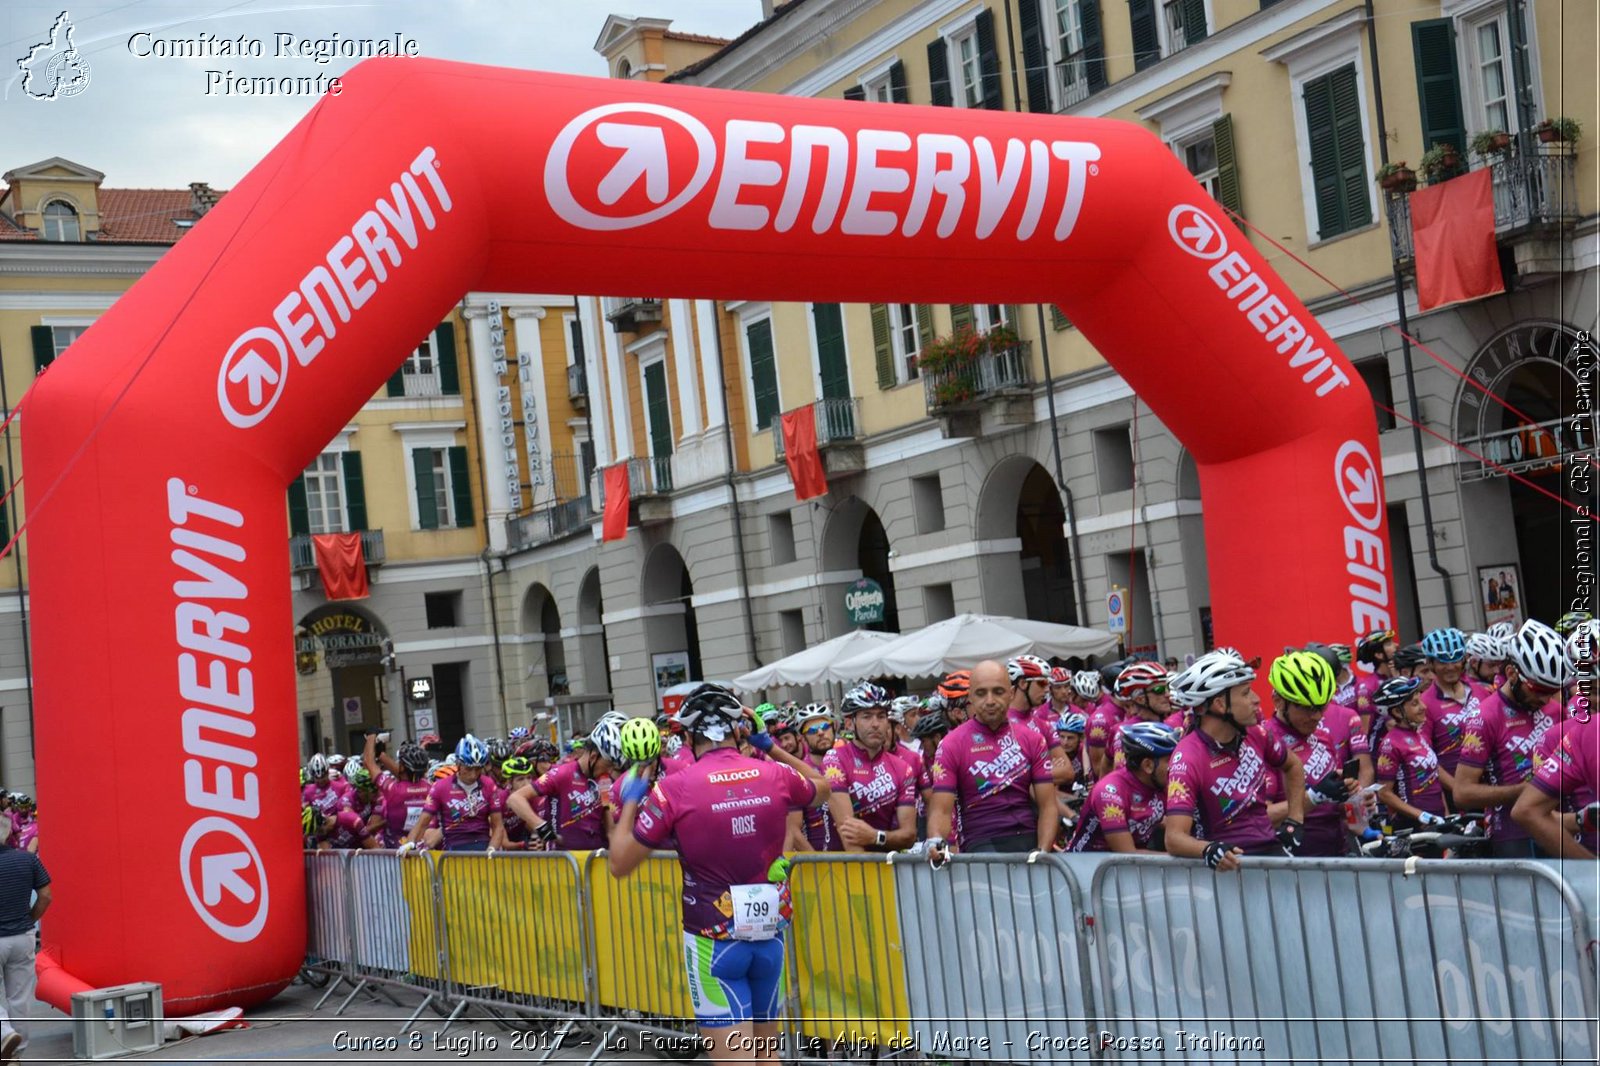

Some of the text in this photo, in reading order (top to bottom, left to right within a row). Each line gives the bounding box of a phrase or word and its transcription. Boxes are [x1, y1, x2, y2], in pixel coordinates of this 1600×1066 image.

[708, 119, 1101, 242] ENERVIT
[273, 146, 453, 367] ENERVIT
[1208, 251, 1350, 397] ENERVIT
[487, 301, 521, 510] BANCA POPOLARE
[519, 354, 544, 486] DI NOVARA
[1489, 426, 1591, 464] HOTEL
[312, 614, 363, 635] HOTEL
[167, 477, 260, 819] ENERVIT
[1505, 734, 1525, 752] LA
[1519, 715, 1554, 755] FAUSTO
[708, 768, 760, 783] BALOCCO
[968, 742, 1022, 778] LA FAUSTO
[995, 752, 1026, 778] COPPI
[1210, 746, 1256, 797] LA FAUSTO
[1237, 754, 1263, 794] COPPI
[711, 795, 771, 812] ARMANDO
[856, 772, 893, 800] FAUSTO
[867, 780, 897, 803] COPPI
[731, 814, 757, 835] ROSE
[744, 901, 770, 917] 799
